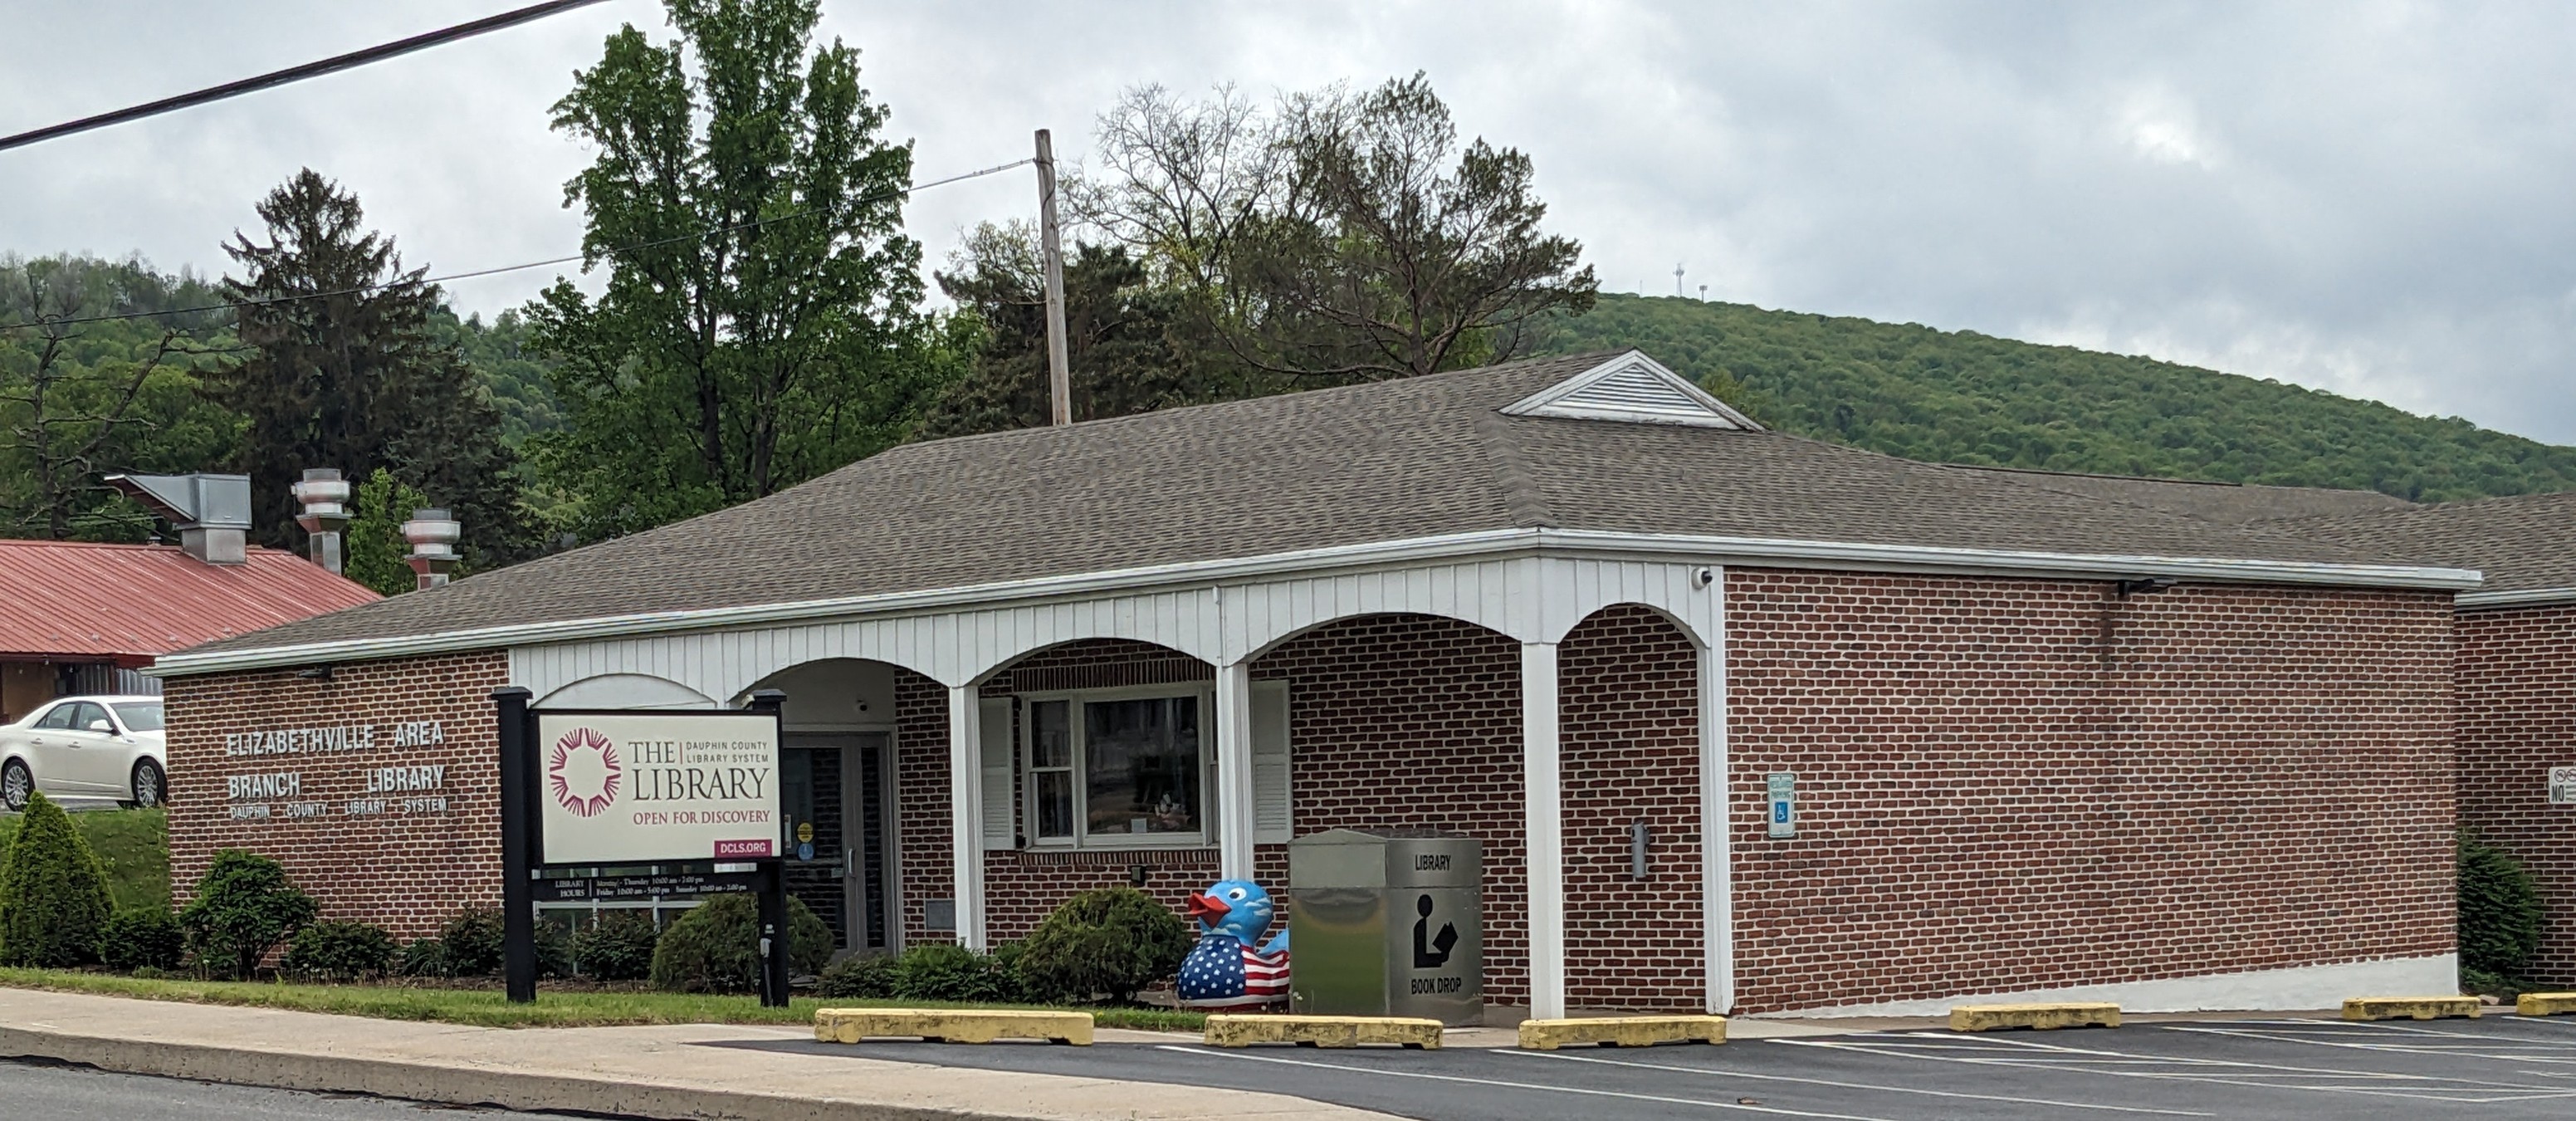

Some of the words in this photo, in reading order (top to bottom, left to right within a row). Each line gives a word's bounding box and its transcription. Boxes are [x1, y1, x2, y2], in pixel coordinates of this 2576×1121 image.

[227, 724, 374, 756] ELIZABETHVILLE
[394, 722, 444, 747] AREA
[686, 742, 728, 750] DAUPHIN
[731, 742, 767, 750] COUNTY
[628, 741, 676, 763] THE
[687, 754, 728, 763] LIBRARY
[732, 754, 769, 762] SYSTEM
[229, 774, 301, 799] BRANCH
[368, 766, 445, 792] LIBRARY
[632, 768, 770, 800] LIBRARY
[2552, 785, 2564, 802] NO
[231, 805, 270, 819] DAUPHIN
[286, 803, 327, 817] COUNTY
[345, 800, 387, 815] LIBRARY
[404, 798, 447, 813] SYSTEM
[633, 812, 668, 825] OPEN
[673, 811, 697, 825] FOR
[701, 810, 770, 824] DISCOVERY
[721, 843, 766, 854] DCLS.ORG
[1415, 854, 1451, 871] LIBRARY
[1411, 978, 1435, 995] BOOK
[1437, 977, 1462, 993] DROP
